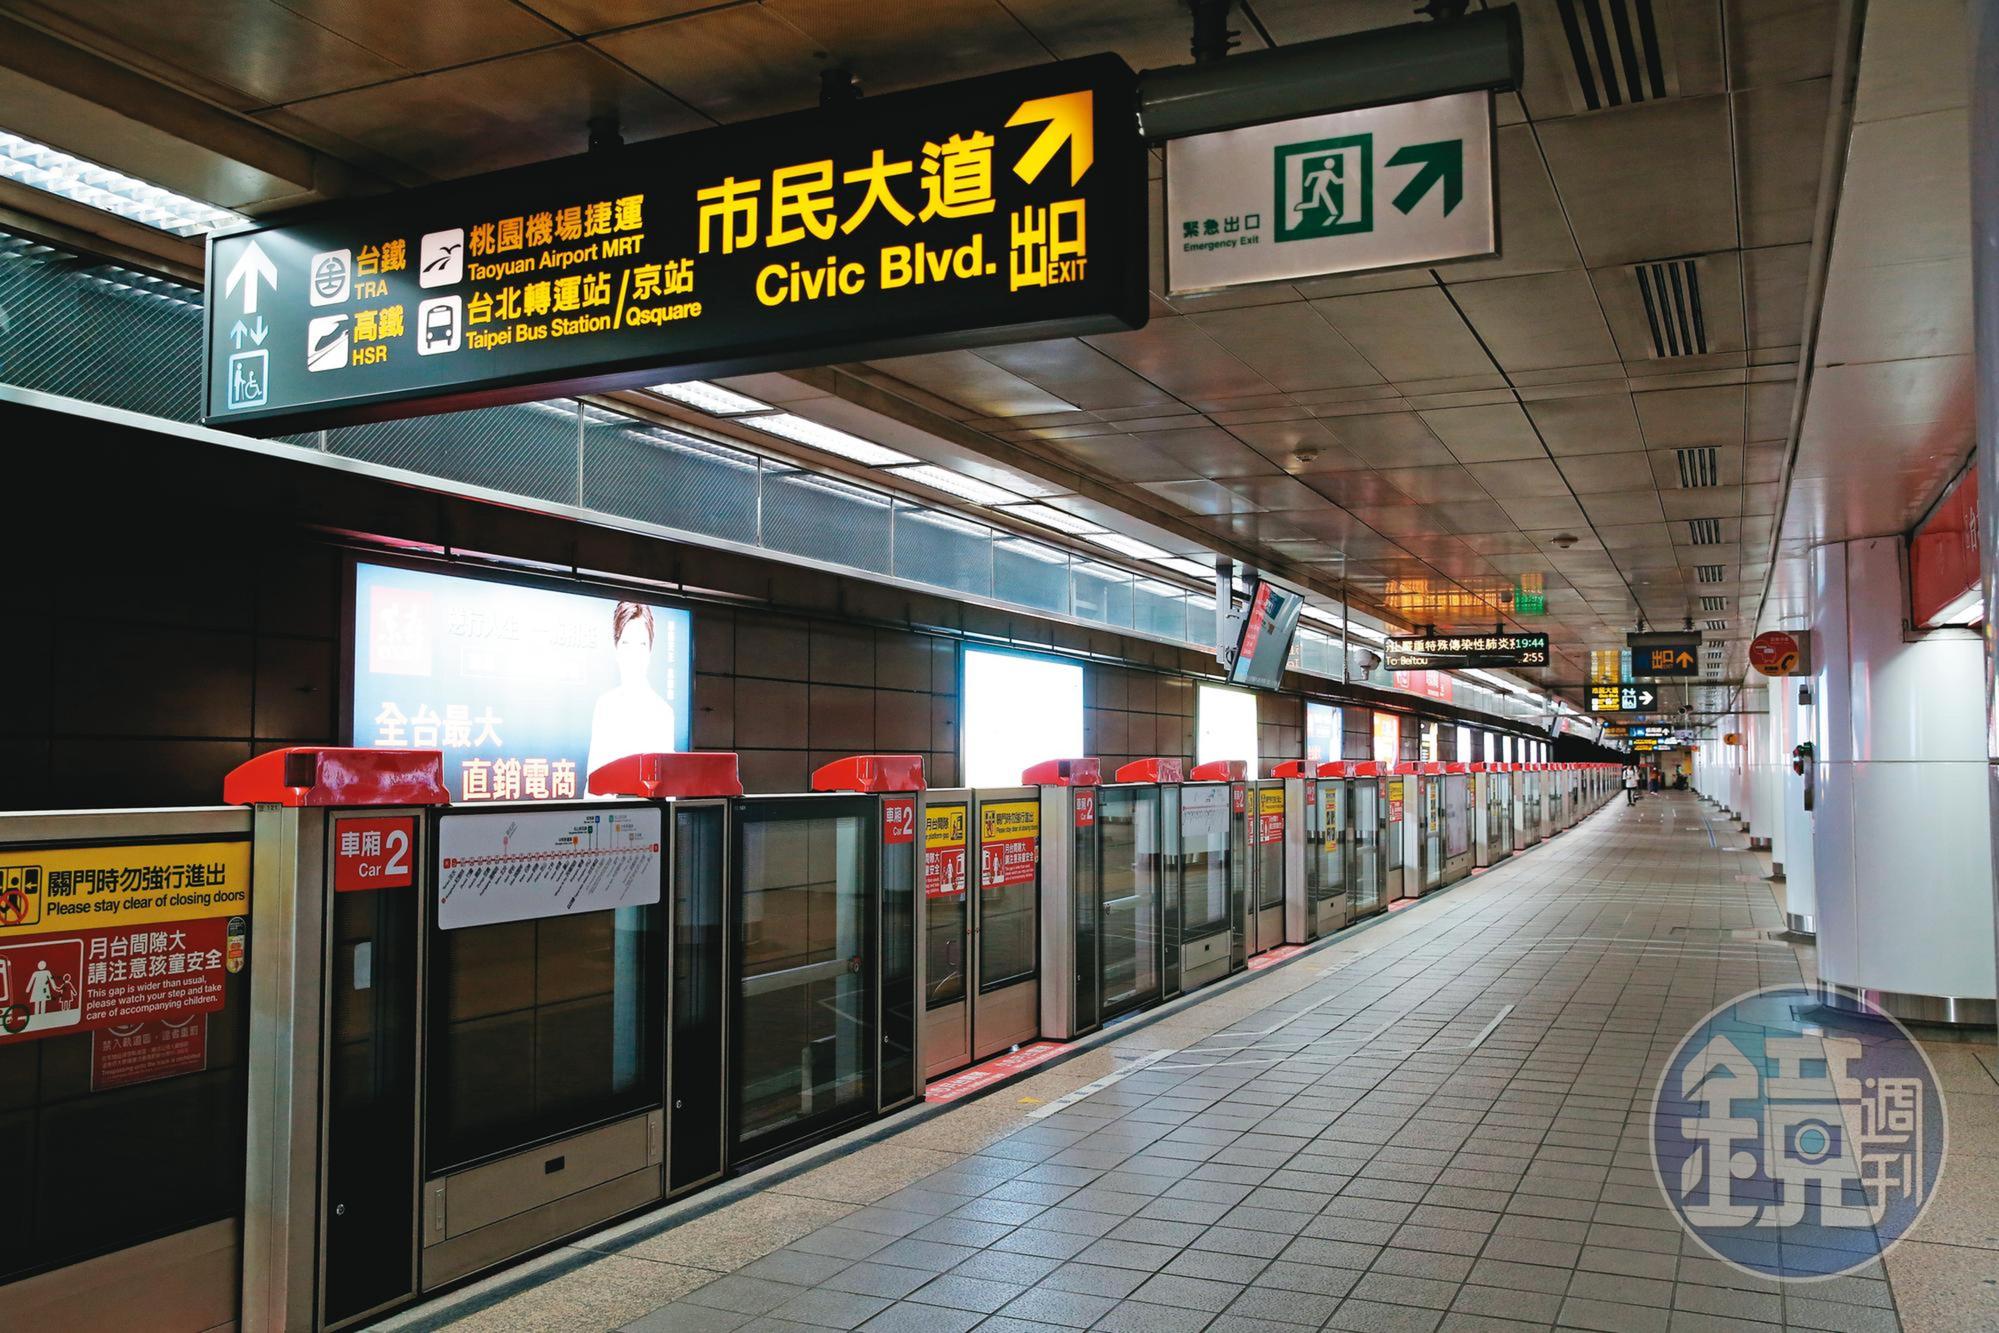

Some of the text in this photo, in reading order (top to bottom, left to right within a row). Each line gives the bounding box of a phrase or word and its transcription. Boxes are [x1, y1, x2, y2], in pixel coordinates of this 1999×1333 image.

[697, 130, 996, 254] 市民大道
[469, 194, 644, 257] 桃園機場捷運
[1183, 214, 1260, 238] 緊急出口
[1010, 198, 1086, 292] 出口
[1184, 234, 1259, 252] Emergency Exit
[356, 240, 406, 278] 台鐵
[468, 235, 644, 282] Taoyuan Airport MRT
[755, 234, 996, 307] Civic Blvd.
[1048, 258, 1087, 284] EXIT
[354, 281, 388, 300] TRA
[353, 305, 404, 345] 高鐵
[466, 301, 702, 351] Taipei Bus Station Qsquare
[352, 344, 388, 366] HSR
[1516, 638, 1544, 649] 19:44
[1386, 655, 1428, 666] To Beitou
[1523, 652, 1544, 663] 2:55
[1651, 650, 1673, 670] 出口
[374, 702, 504, 748] 全台最大
[461, 758, 576, 800] 直銷電商
[903, 806, 913, 835] 2
[1087, 797, 1093, 819] 2
[340, 829, 409, 875] 車廂 2
[47, 862, 226, 898] 關門時勿強行進出
[358, 862, 381, 878] Car
[46, 890, 245, 916] Please stay clear of closing doors
[89, 930, 186, 960] 月台間隙大
[88, 949, 222, 984] 請注意孩童安全
[87, 975, 207, 998] This gap is wider than usual,
[87, 984, 222, 1010] please watch your step and take
[86, 995, 218, 1021] care of accompanying children.
